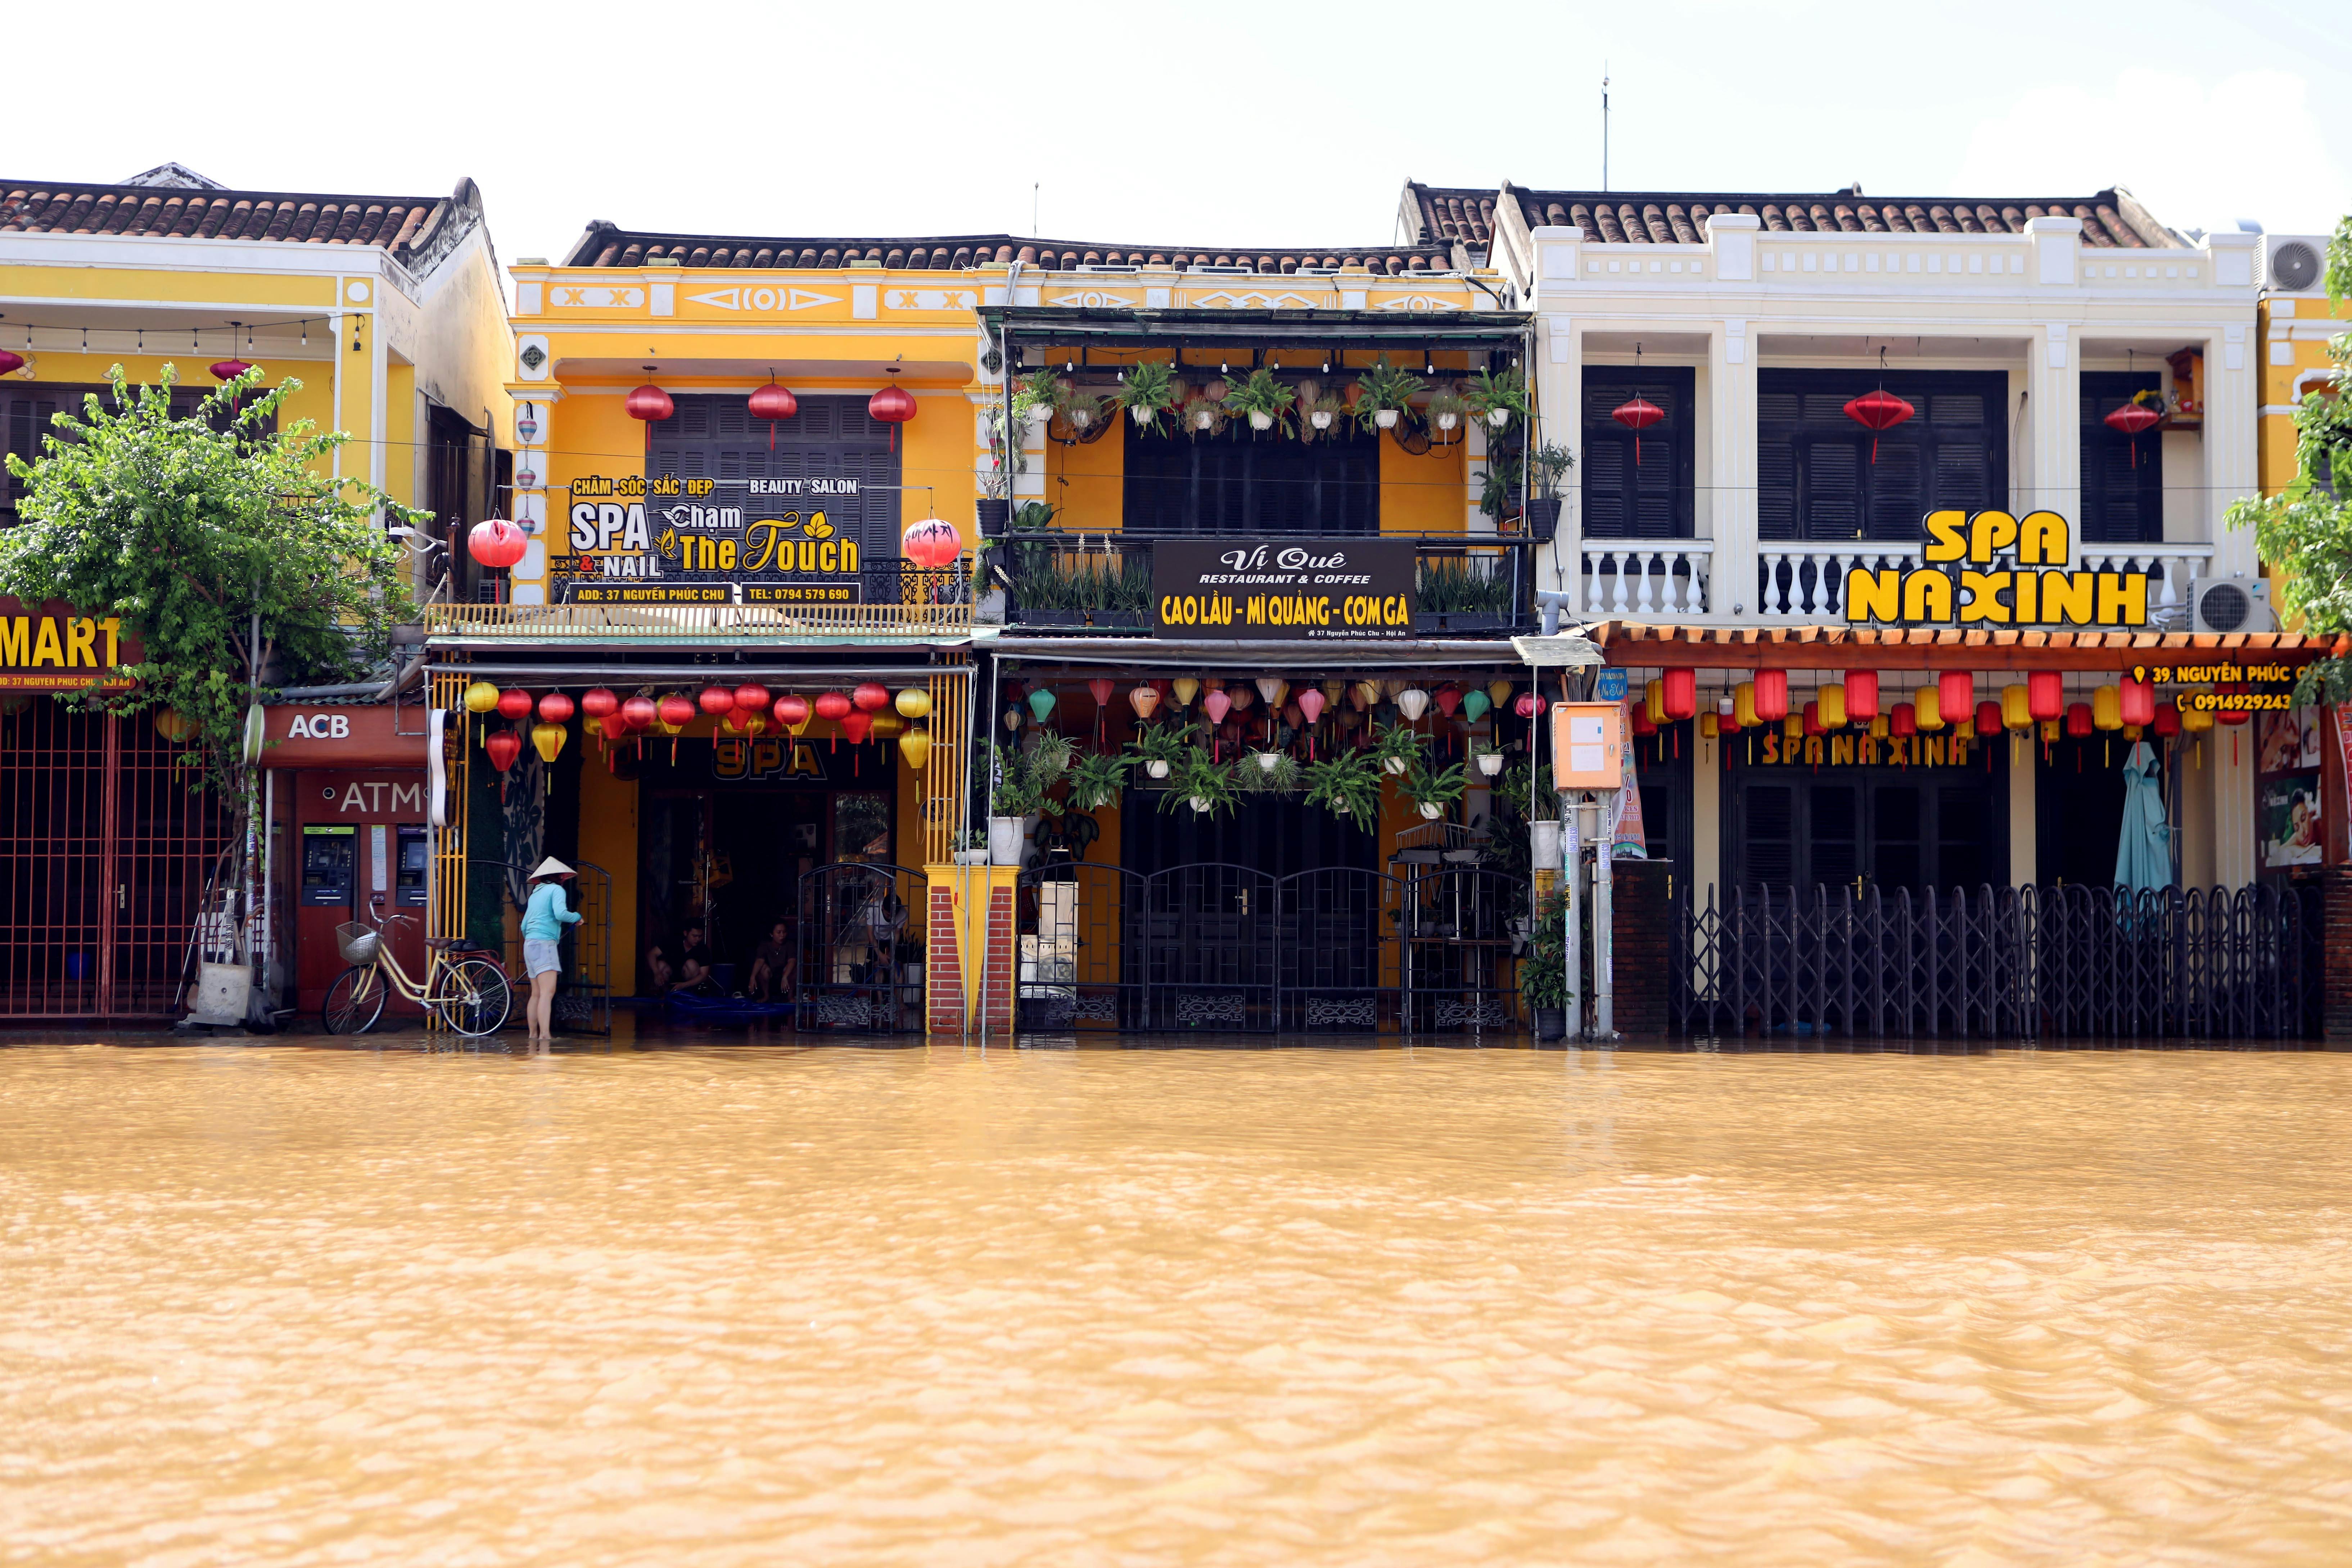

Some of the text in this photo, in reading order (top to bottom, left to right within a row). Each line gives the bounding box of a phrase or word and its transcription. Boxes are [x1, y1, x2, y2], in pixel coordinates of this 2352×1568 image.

[573, 473, 713, 498] CHĂM SÓC SẮC ĐẸP
[750, 479, 857, 494] BEAUTY SALON
[572, 503, 650, 551] SPA
[662, 504, 741, 532] Chạm
[680, 511, 859, 572] The Touch
[1926, 510, 2068, 565] SPA
[579, 556, 662, 577] & NAIL
[1221, 544, 1346, 570] Vị Quê
[1199, 575, 1371, 584] RESTAURANT & COFFEE
[578, 586, 724, 601] ADD: 37 NGUYỄN PHÚC CHU
[750, 589, 849, 599] TEL: 0794 579 690
[1161, 596, 1197, 625] CAO
[1201, 590, 1232, 625] LẦU
[1247, 593, 1265, 625] MÌ
[1269, 590, 1329, 626] QUẢNG
[1344, 596, 1381, 625] CƠM
[1384, 593, 1408, 625] GÀ
[0, 616, 120, 667] MART
[24, 677, 55, 686] NGUYEN
[57, 678, 78, 686] PHUC
[2152, 667, 2171, 683] 39
[2177, 662, 2242, 682] NGUYỄN
[2248, 662, 2290, 682] PHÚC
[2194, 694, 2291, 710] 0914929243
[288, 714, 349, 738] ACB
[713, 740, 827, 780] SPA
[1763, 735, 1823, 764] SPA
[340, 782, 420, 812] ATM
